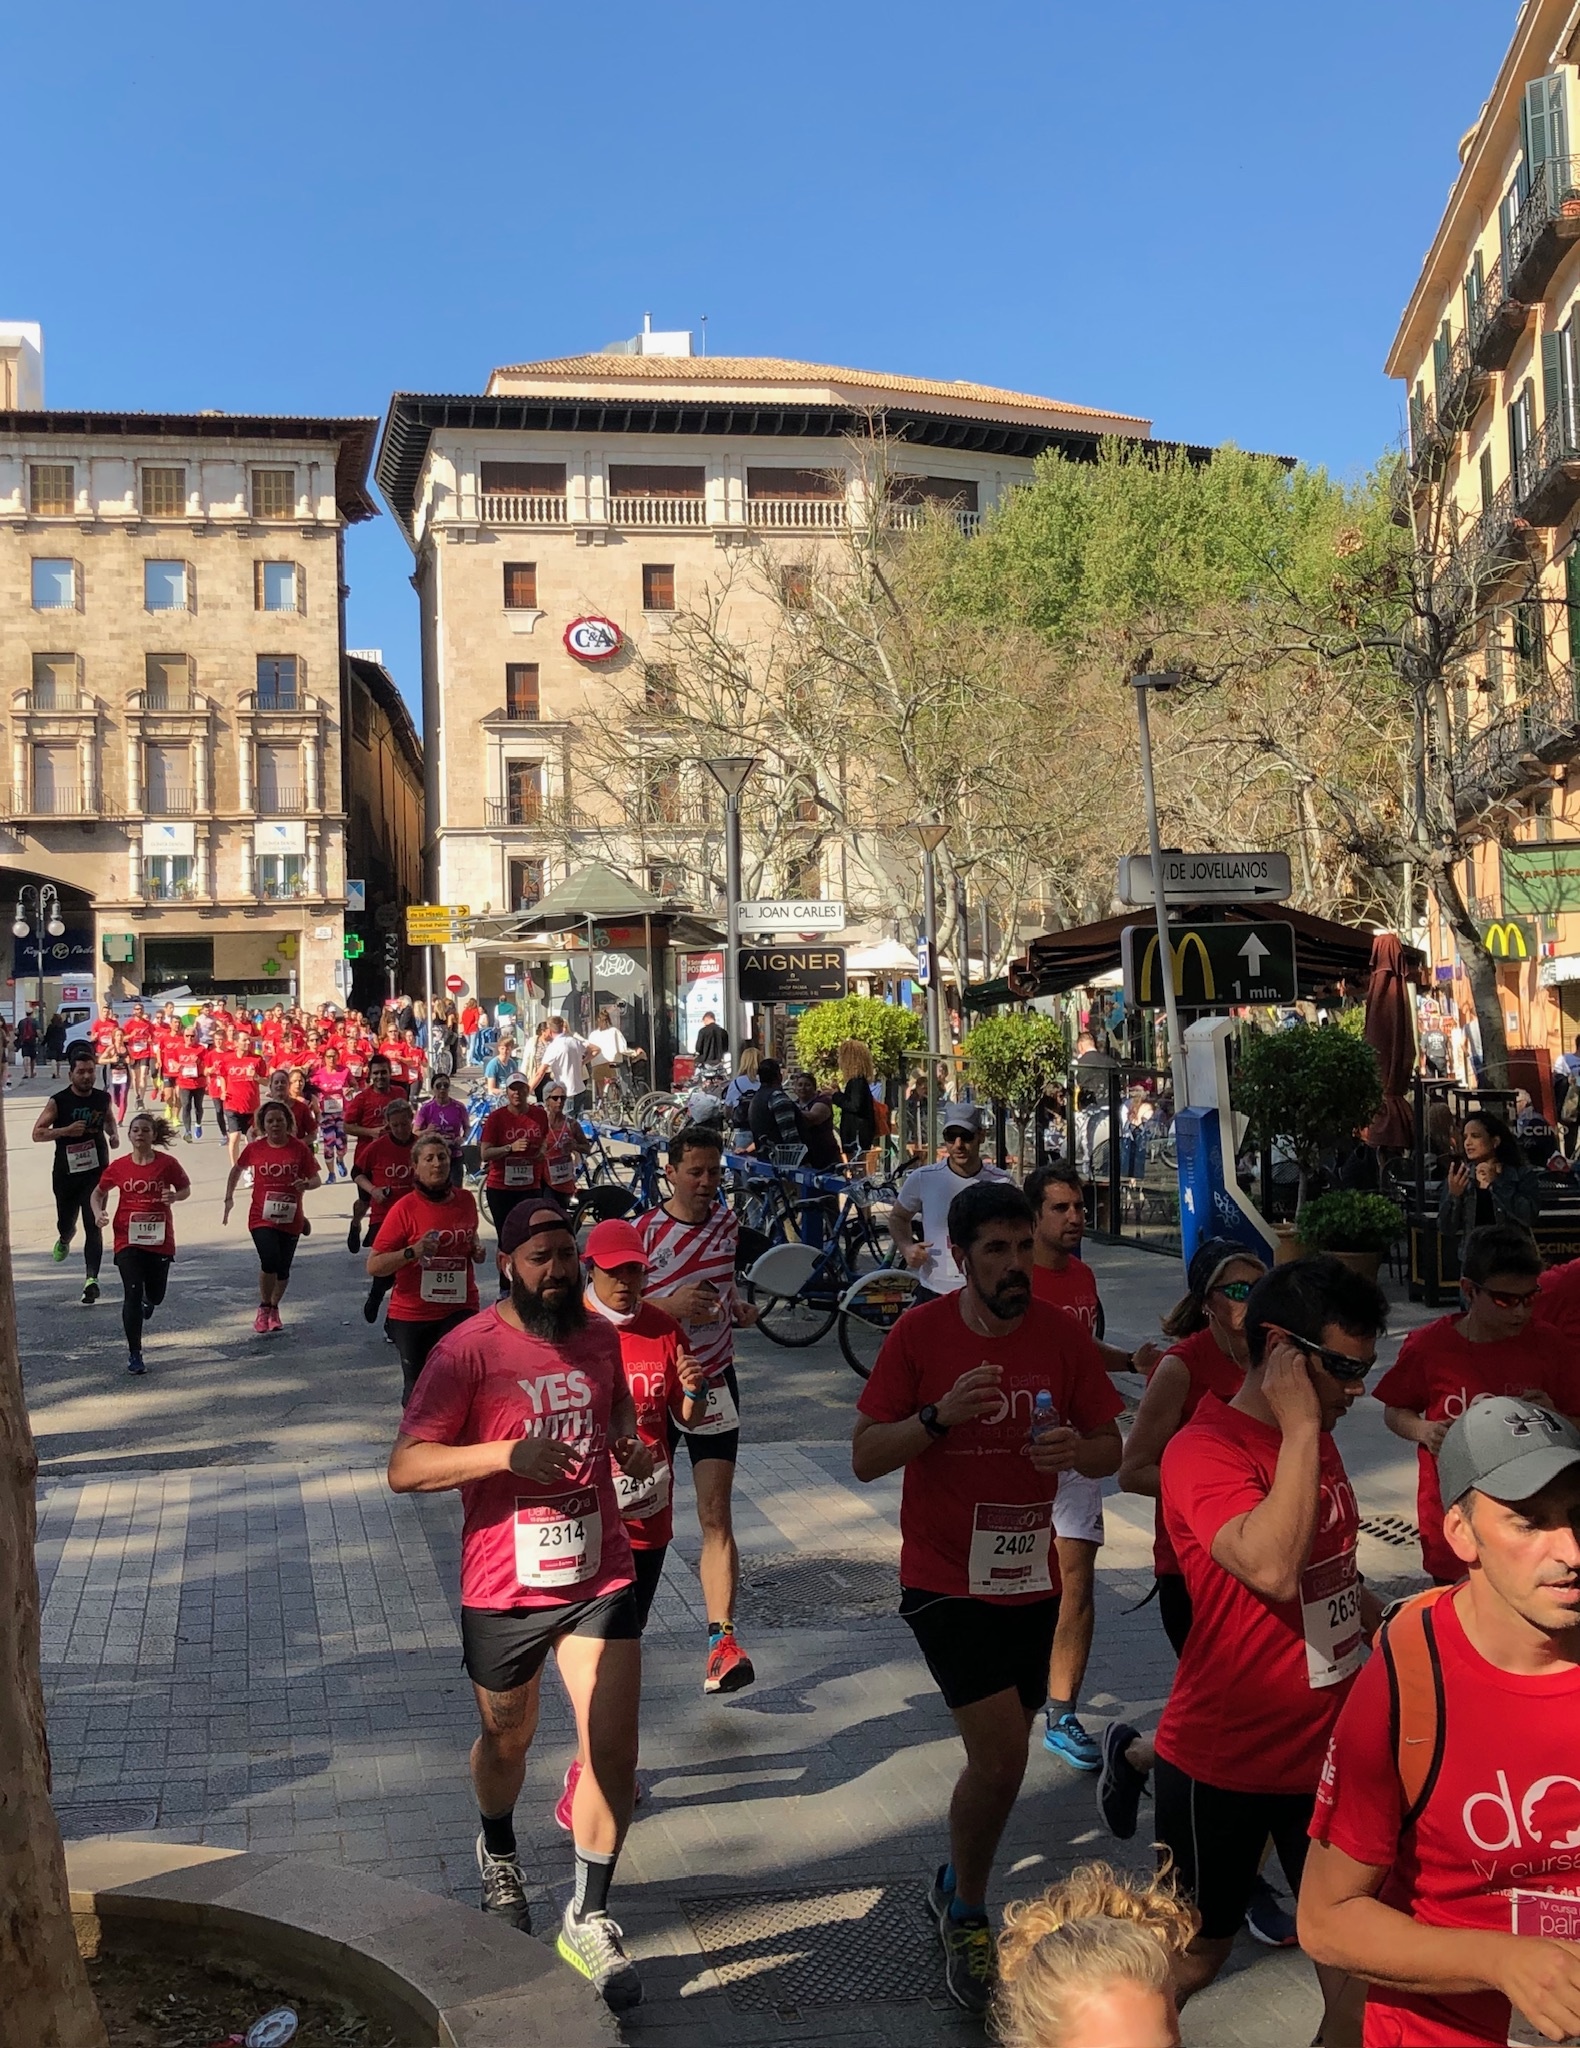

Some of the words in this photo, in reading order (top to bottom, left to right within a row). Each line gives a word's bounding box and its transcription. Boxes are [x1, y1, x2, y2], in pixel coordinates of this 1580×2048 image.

[575, 628, 612, 648] C&A
[1190, 861, 1268, 879] JOVELLANOS
[739, 907, 754, 918] PL.
[758, 907, 789, 918] JOAN
[794, 906, 836, 918] CARLES
[687, 964, 719, 973] POSTGRAU
[744, 953, 841, 971] AIGNER
[1232, 980, 1241, 999] 1
[1250, 986, 1281, 999] min.
[436, 1272, 455, 1283] 815
[627, 1360, 664, 1372] palma
[517, 1370, 592, 1415] YES
[539, 1521, 585, 1546] 2314
[993, 1533, 1036, 1555] 2402
[1551, 1903, 1577, 1915] cursa
